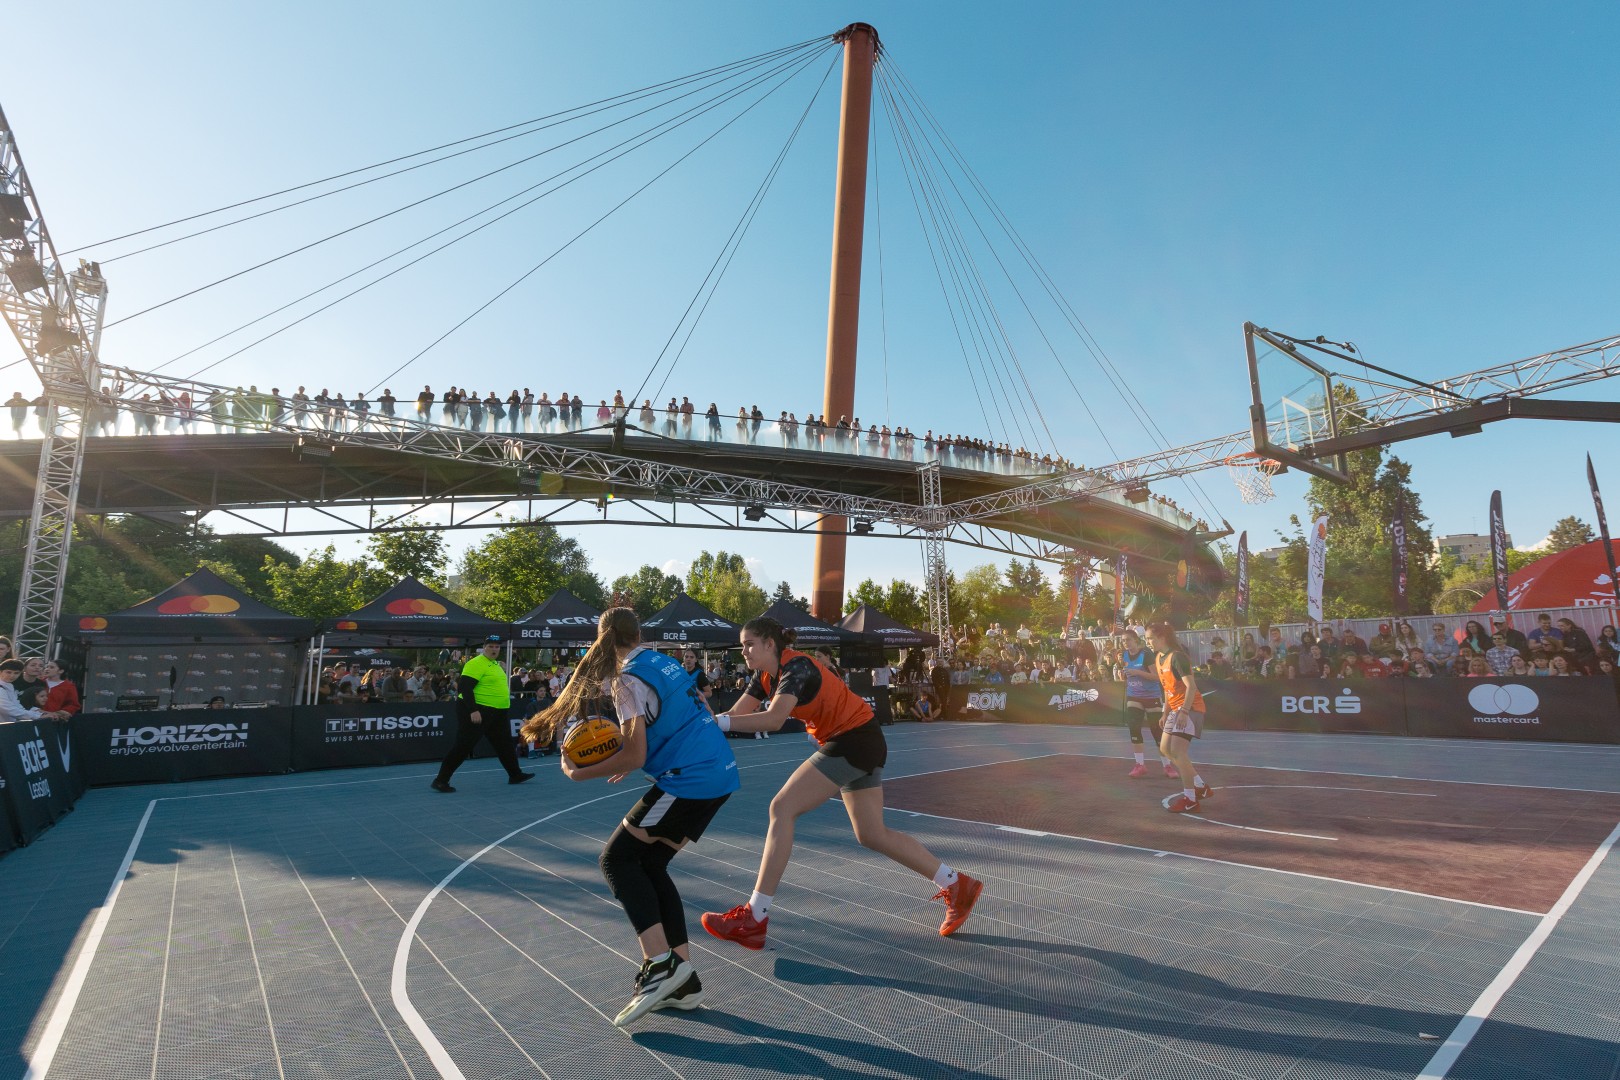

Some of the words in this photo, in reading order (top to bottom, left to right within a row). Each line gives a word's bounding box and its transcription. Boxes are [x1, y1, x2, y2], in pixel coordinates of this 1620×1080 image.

[546, 616, 592, 625] BCR
[678, 618, 716, 628] BCR
[521, 629, 541, 638] BCR
[967, 691, 1007, 710] ROM
[1281, 695, 1332, 714] BCR
[360, 715, 444, 731] TISSOT
[1473, 716, 1540, 724] mastercard
[110, 722, 249, 747] HORIZON
[356, 733, 396, 741] WATCHES
[399, 731, 423, 739] SINCE
[109, 739, 248, 756] enjoy.evolve.entertain.
[577, 737, 619, 758] Wilson
[18, 740, 43, 776] BCR
